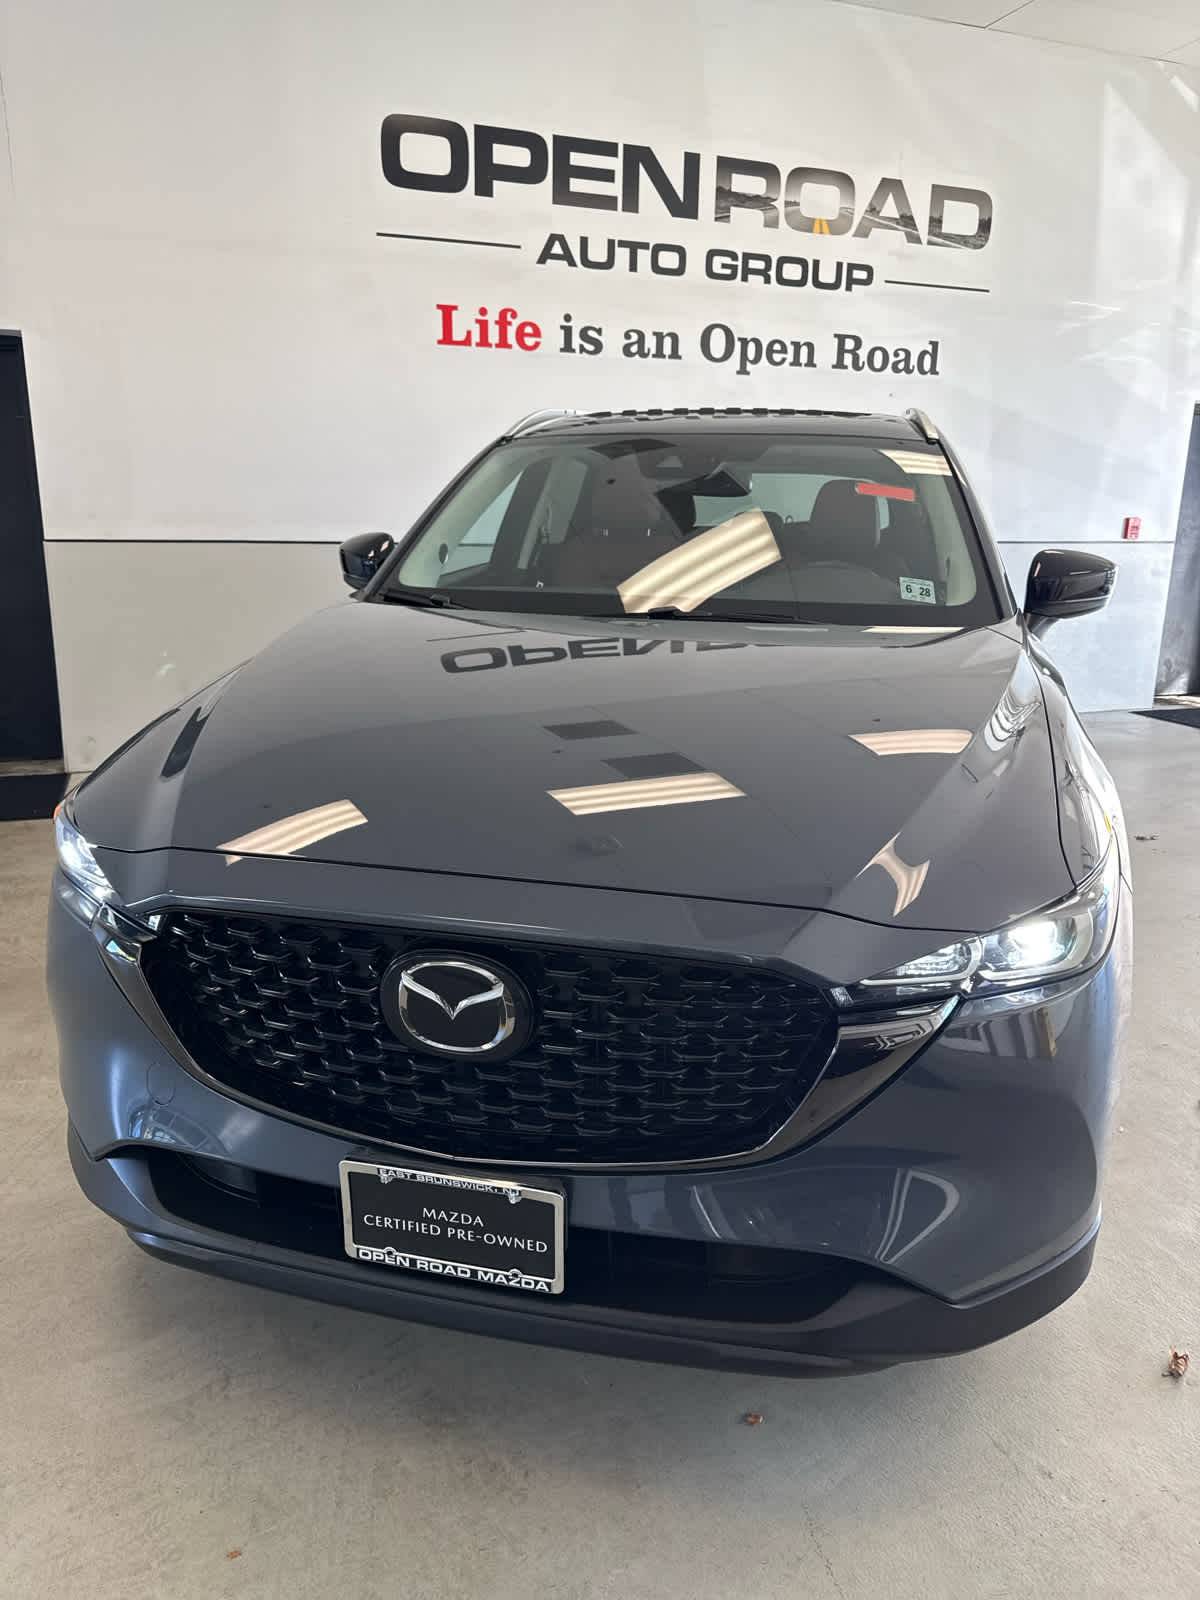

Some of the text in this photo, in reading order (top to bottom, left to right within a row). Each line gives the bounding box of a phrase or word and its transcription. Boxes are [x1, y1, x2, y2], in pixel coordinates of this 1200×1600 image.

[381, 113, 993, 250] OPEN ROAD
[536, 233, 874, 292] AUTO GROUP
[436, 303, 939, 375] Life is an Open Road
[379, 1168, 412, 1180] EAST
[363, 1214, 548, 1253] CERTIFIED PRE-OWNED
[422, 1207, 484, 1227] MAZDA
[359, 1249, 550, 1292] OPEN ROAD MAZDA
